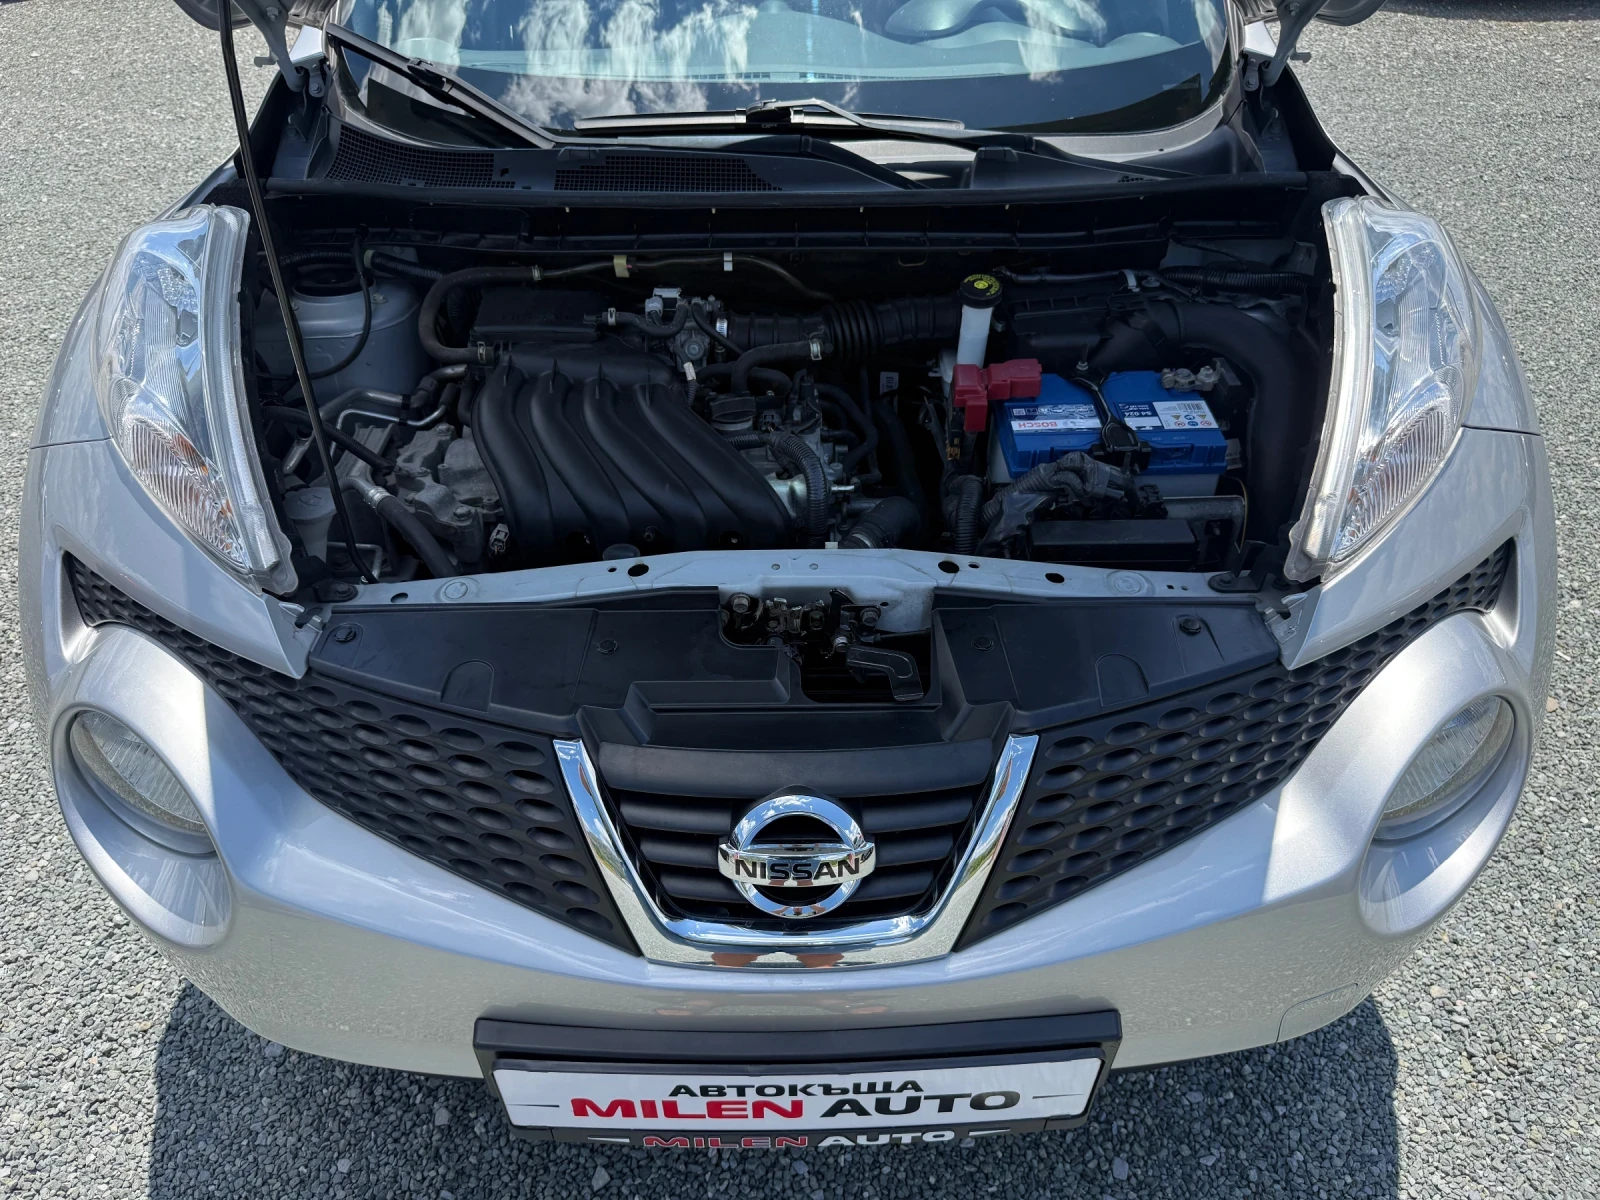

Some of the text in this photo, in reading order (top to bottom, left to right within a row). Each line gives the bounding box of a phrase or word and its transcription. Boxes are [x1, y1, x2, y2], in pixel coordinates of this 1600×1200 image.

[1017, 421, 1058, 429] BOSCH
[735, 857, 860, 880] NISSAN
[668, 1080, 924, 1097] АВТОКЪЩА
[570, 1090, 1021, 1119] MILEN AUTO
[643, 1130, 955, 1148] MILEN AUTO
